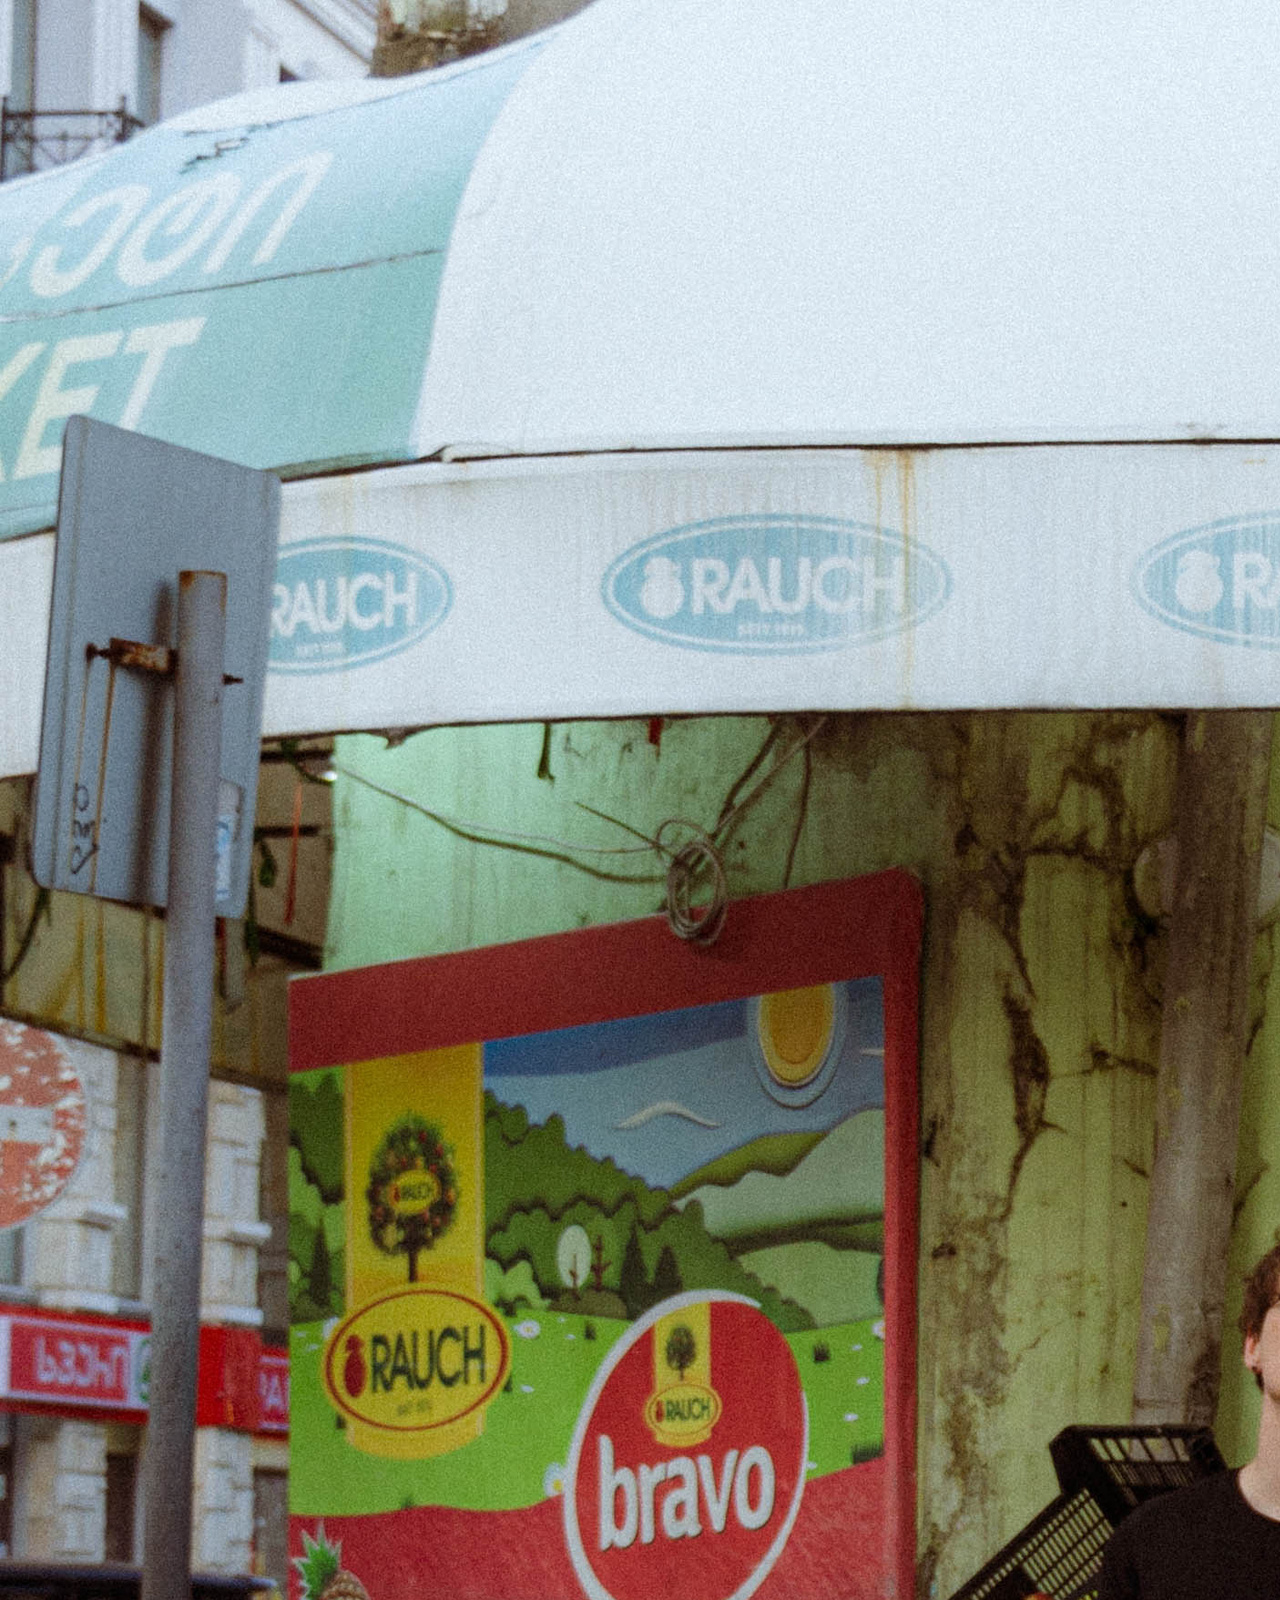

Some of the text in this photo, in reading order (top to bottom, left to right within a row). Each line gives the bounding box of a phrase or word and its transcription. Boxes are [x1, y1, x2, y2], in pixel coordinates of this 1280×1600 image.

[692, 555, 902, 615] RAUCH
[371, 1324, 487, 1393] RAUCH
[665, 1398, 711, 1422] RAUCH
[598, 1434, 776, 1552] bravo
